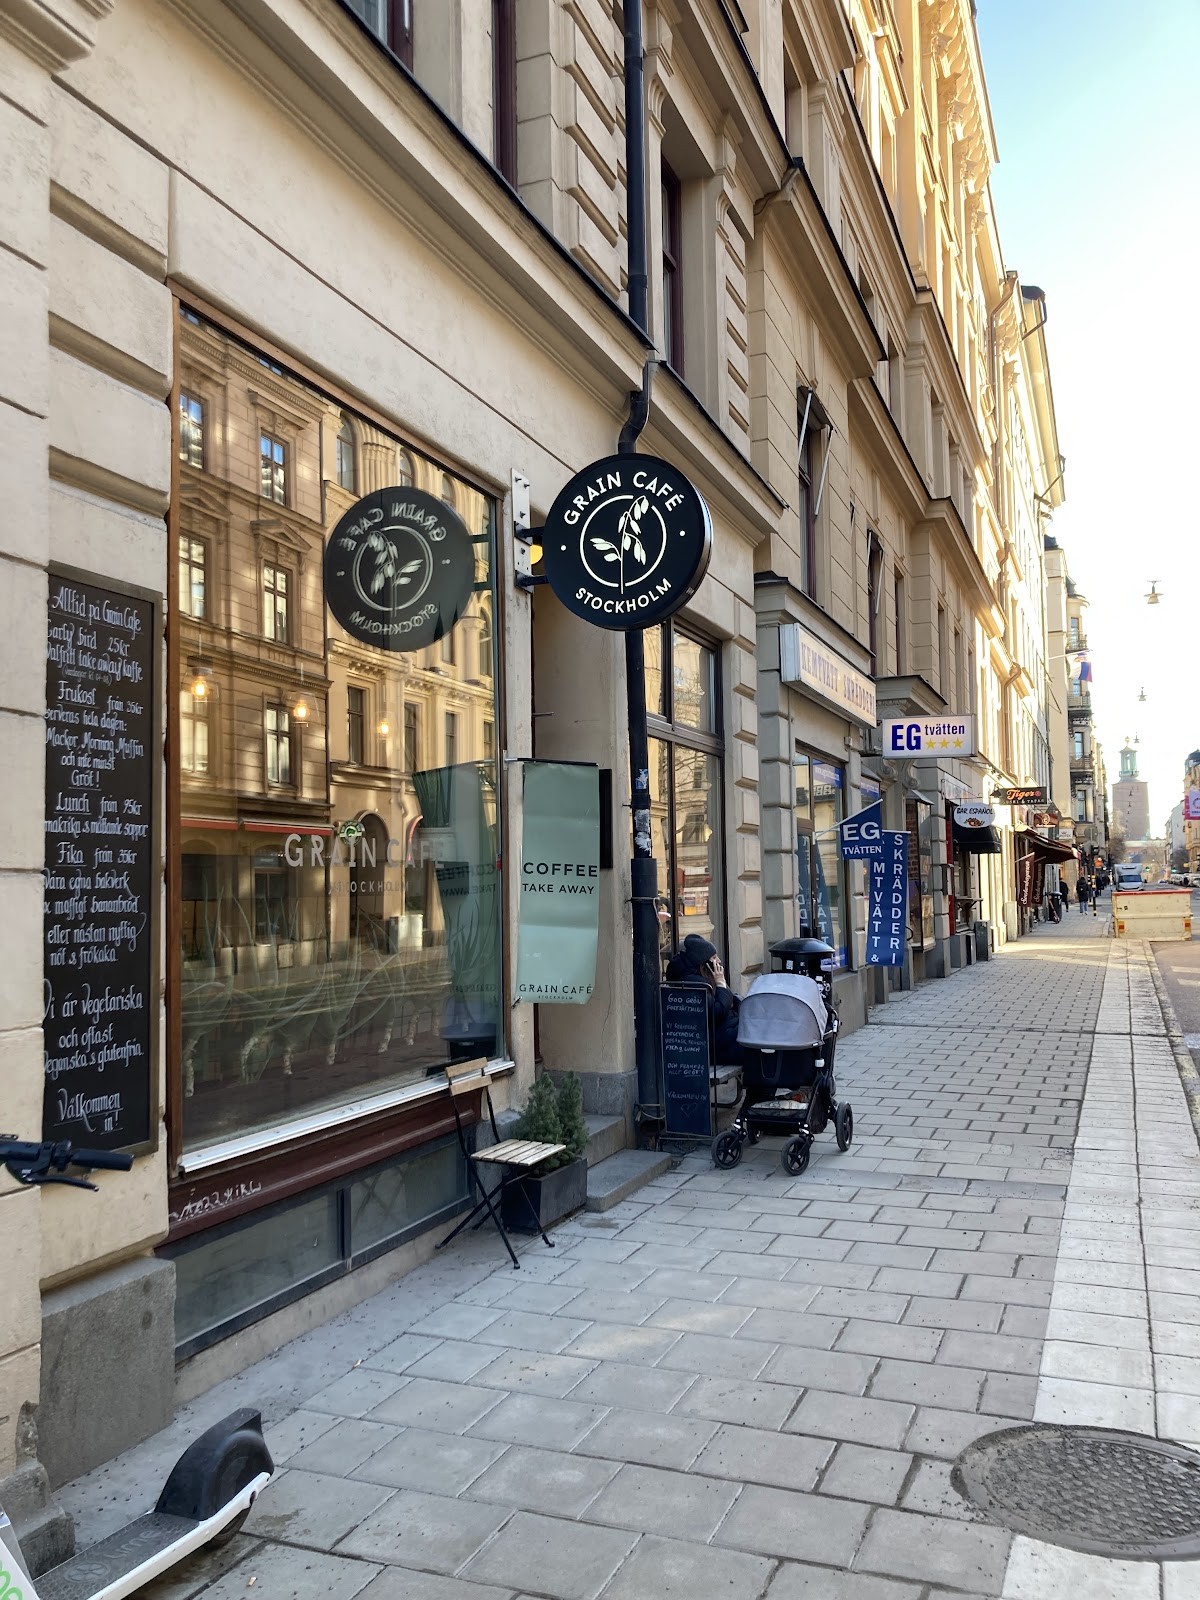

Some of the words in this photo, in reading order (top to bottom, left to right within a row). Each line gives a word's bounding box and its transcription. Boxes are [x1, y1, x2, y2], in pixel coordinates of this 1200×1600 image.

[564, 472, 621, 525] GRAIN
[633, 471, 684, 511] CAFÉ
[52, 586, 86, 618] Alltid
[89, 600, 100, 625] på
[576, 578, 672, 613] STOCKHOLM
[58, 680, 96, 705] Frukost
[107, 696, 123, 714] från
[83, 710, 98, 727] hela
[81, 732, 115, 757] Morning
[116, 738, 144, 759] Muffin
[892, 724, 921, 751] EG
[925, 723, 965, 735] tvätten
[61, 751, 75, 766] och
[77, 752, 92, 767] inte
[93, 755, 116, 770] minst
[56, 792, 89, 812] Lunch
[99, 795, 118, 818] från
[123, 799, 142, 815] 95kr
[956, 807, 968, 815] BAR
[968, 807, 994, 815] ESPAÑOL
[843, 821, 880, 841] EG
[57, 842, 84, 863] Fika
[93, 845, 113, 869] från
[118, 849, 137, 864] 35kr
[285, 833, 376, 868] GRAIN
[843, 845, 882, 855] TVÄTTEN
[523, 862, 598, 877] COFFEE
[69, 869, 92, 898] egna
[94, 869, 135, 893] bakverk
[522, 884, 554, 893] TAKE
[559, 885, 594, 894] AWAY
[55, 896, 87, 920] maffigt
[90, 895, 139, 913] bananbröd
[890, 833, 904, 964] SKRÄDDERI
[47, 925, 71, 944] eller
[73, 923, 105, 943] nästan
[871, 953, 879, 963] &
[519, 984, 558, 994] GRAIN
[562, 984, 592, 994] CAFÉ
[62, 992, 78, 1018] är
[59, 1027, 79, 1048] och
[81, 1022, 113, 1053] oftast
[58, 1088, 120, 1128] Välkommen
